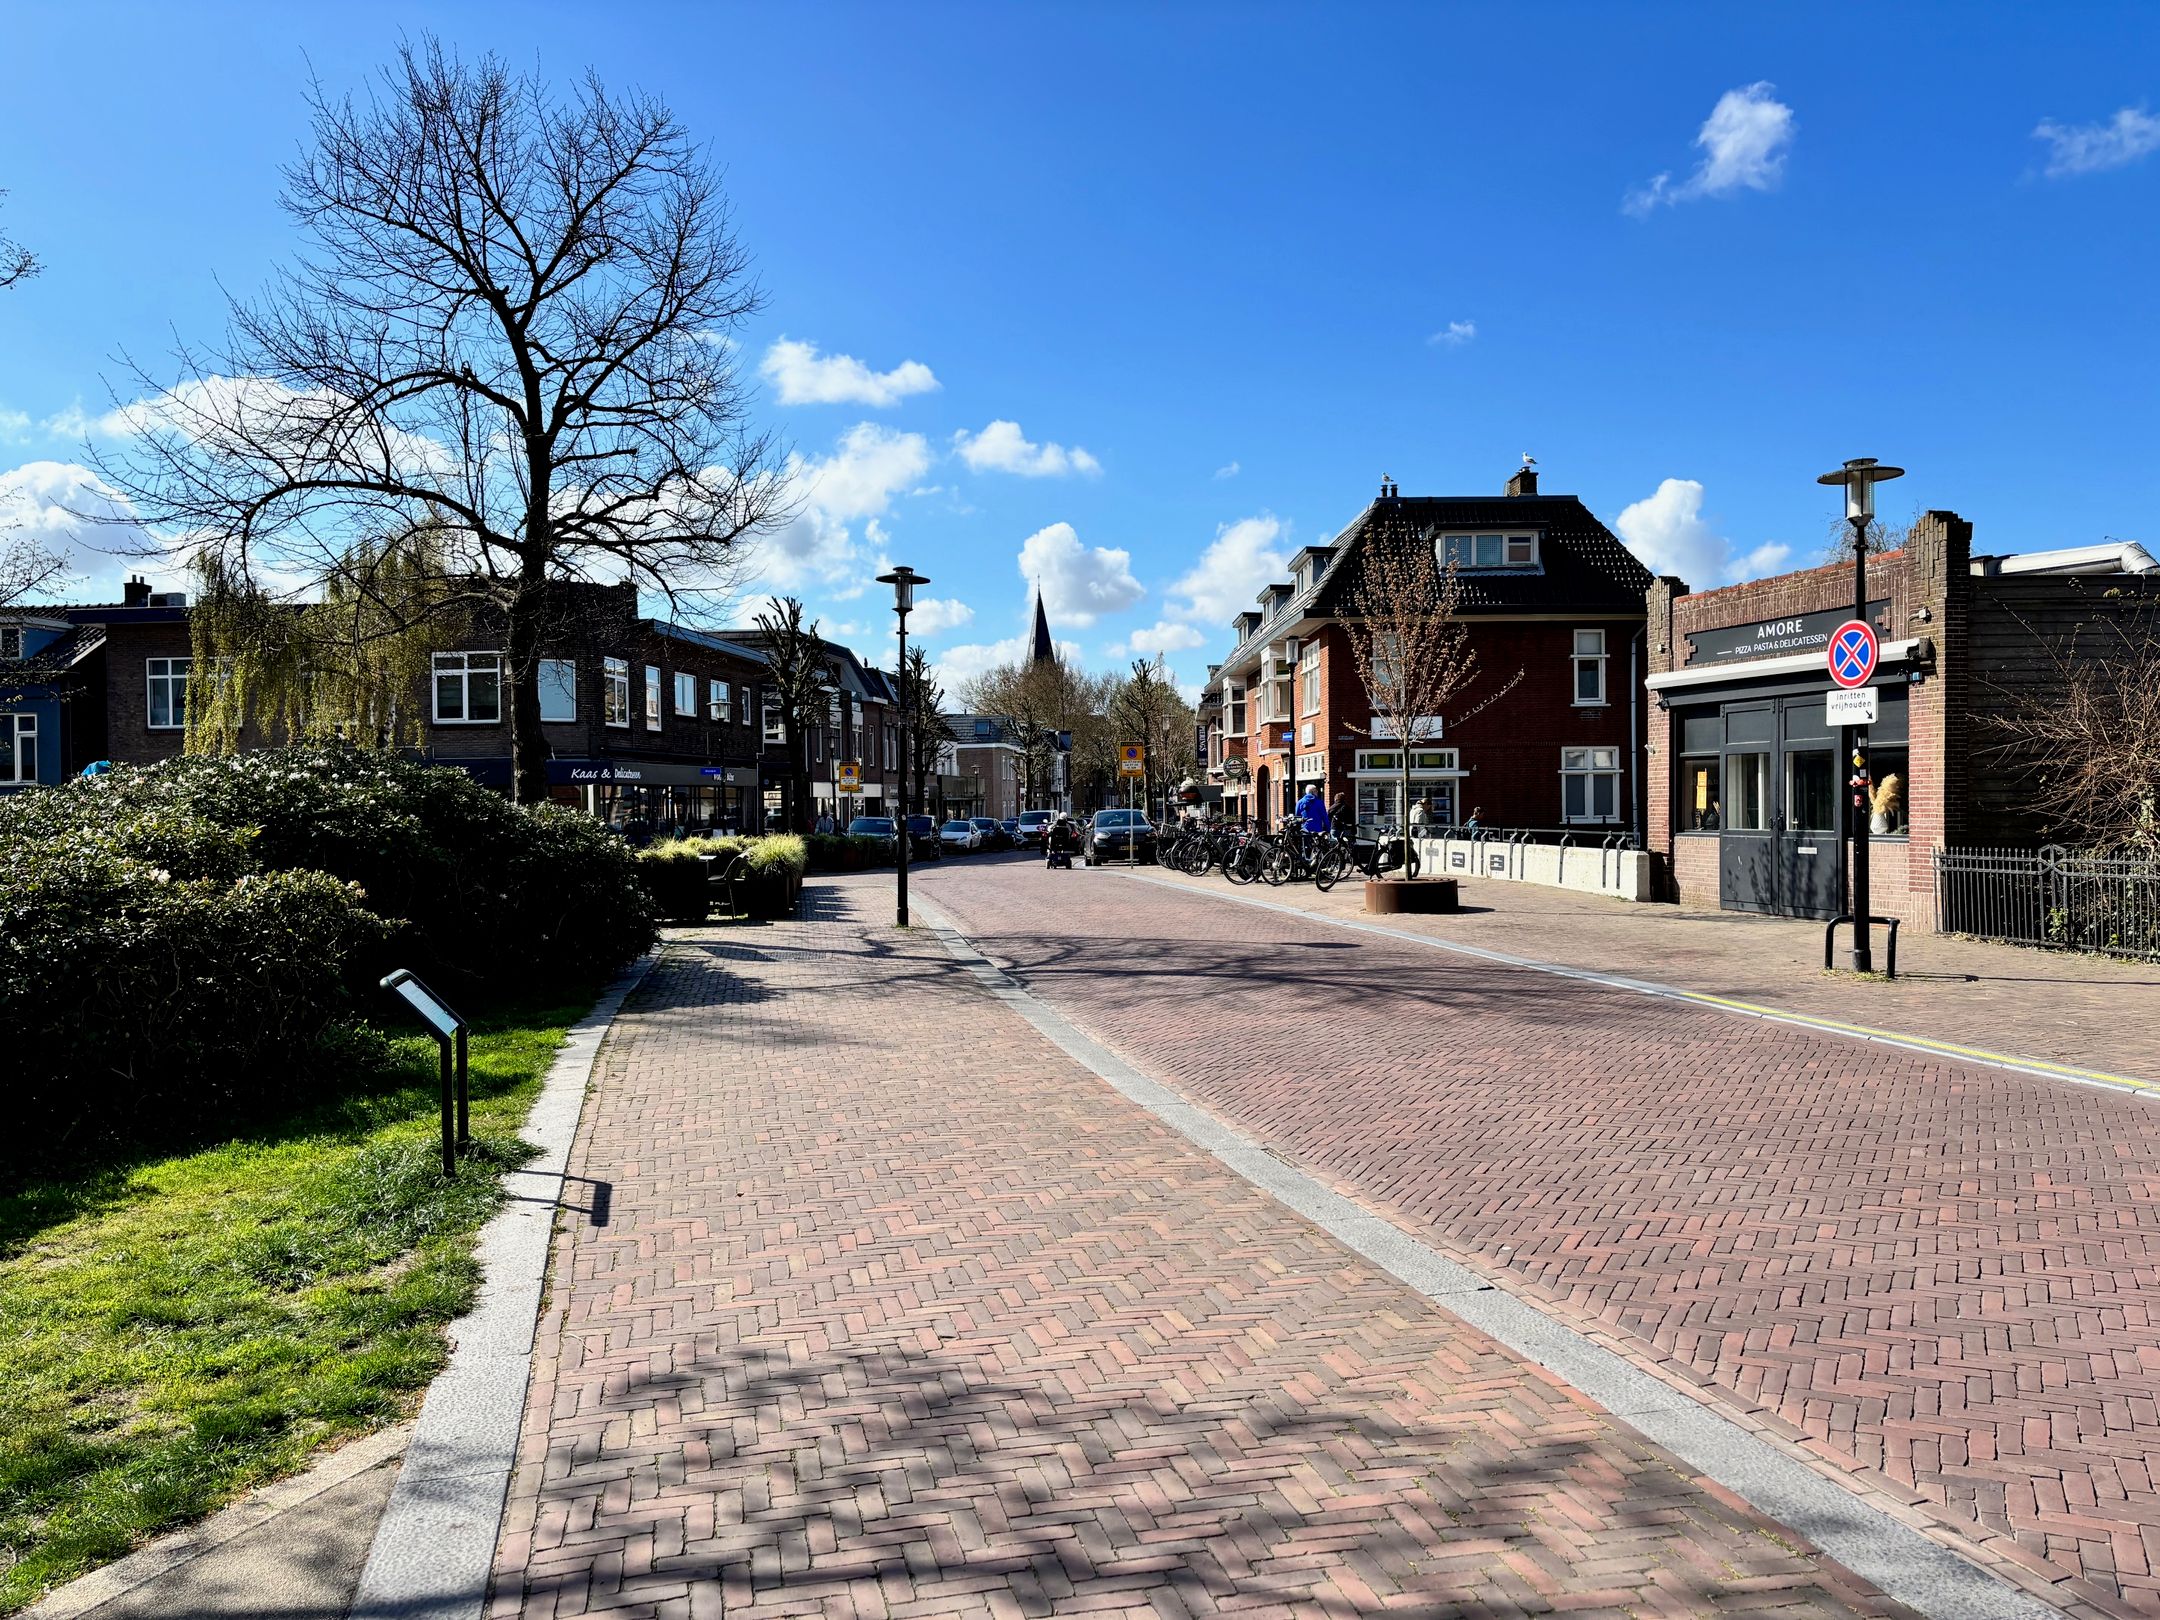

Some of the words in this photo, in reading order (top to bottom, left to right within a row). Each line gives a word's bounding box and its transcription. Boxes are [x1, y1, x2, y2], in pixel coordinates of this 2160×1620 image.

[1757, 619, 1803, 639] AMORE
[1735, 645, 1752, 655] PIZZA
[1753, 642, 1774, 652] PASTA
[1780, 633, 1828, 647] DELICATESSEN
[1836, 692, 1866, 701] Inritten
[1831, 701, 1872, 711] vrijhouden
[571, 768, 599, 779] Kaas
[601, 768, 612, 779] &
